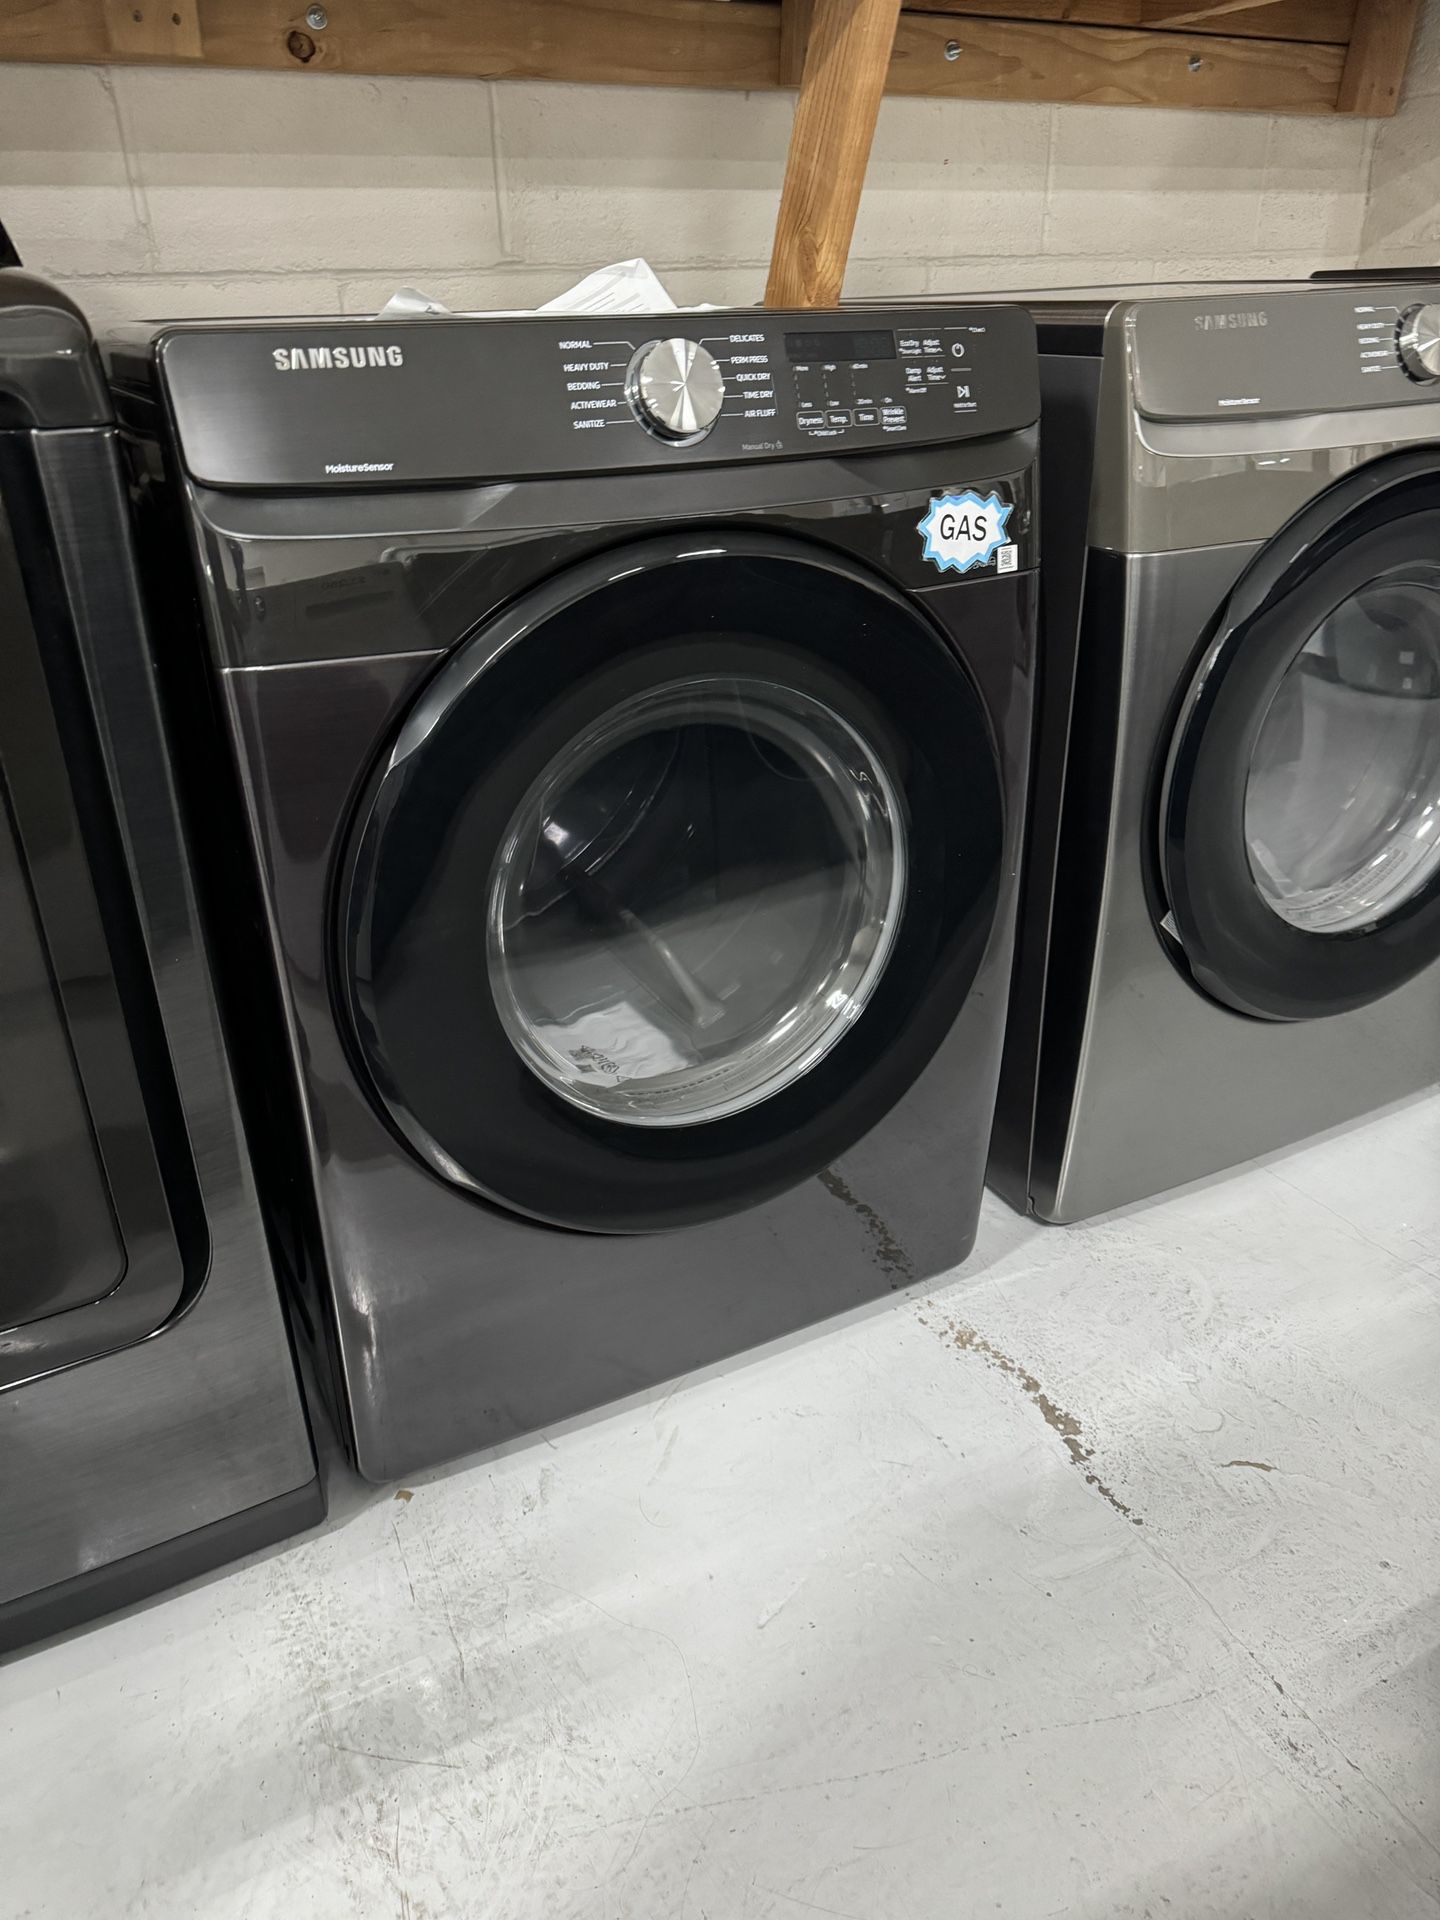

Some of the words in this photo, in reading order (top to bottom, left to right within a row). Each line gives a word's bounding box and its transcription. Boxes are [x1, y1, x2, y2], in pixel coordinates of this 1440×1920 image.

[1194, 311, 1269, 331] SAMSUNG
[729, 334, 765, 343] DELICATES
[558, 340, 592, 349] NORMAL
[273, 345, 404, 371] SAMSUNG
[731, 356, 748, 364] PERM
[749, 355, 769, 363] PRESS
[563, 364, 588, 372] HEAVY
[589, 362, 609, 371] DUTY
[736, 374, 756, 382] QUICK
[756, 373, 771, 381] DRY
[567, 382, 601, 391] BEDDING
[743, 391, 758, 399] TIME
[758, 390, 773, 398] DRY
[571, 400, 617, 410] ACTIVEWEAR
[744, 410, 756, 418] AIR
[757, 409, 776, 417] FLUFF
[858, 413, 875, 422] Time
[573, 419, 606, 429] SANITIZE
[799, 417, 824, 426] Dryness
[742, 443, 763, 451] Manual
[764, 442, 775, 450] Dry
[325, 463, 394, 474] MoistureSensor
[940, 514, 987, 542] GAS
